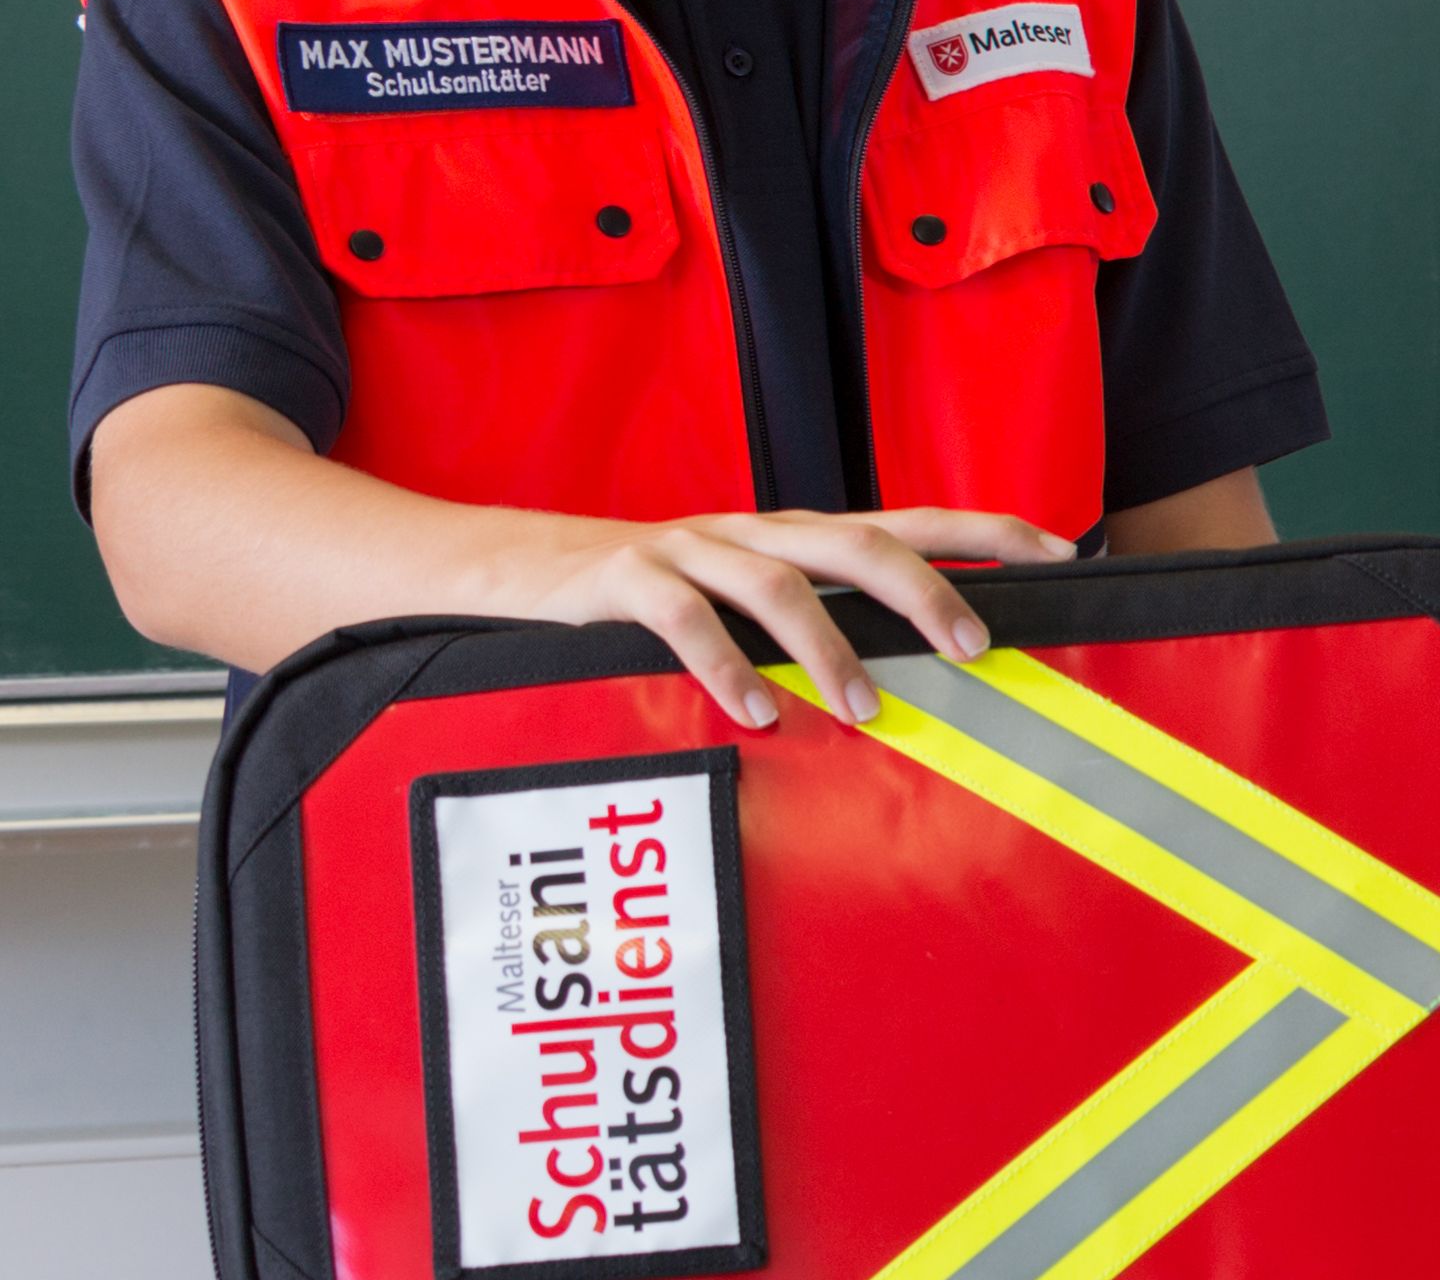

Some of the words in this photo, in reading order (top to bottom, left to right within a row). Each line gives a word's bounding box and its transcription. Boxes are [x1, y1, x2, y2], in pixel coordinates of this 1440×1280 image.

[299, 39, 373, 70] MAX
[383, 35, 605, 70] MUSTERMANN
[968, 19, 1073, 55] Malteser
[366, 67, 552, 98] Schulsanitäter
[491, 877, 527, 1015] Malteser
[508, 846, 608, 1240] Schulsani
[588, 798, 690, 1234] tätsdienst
